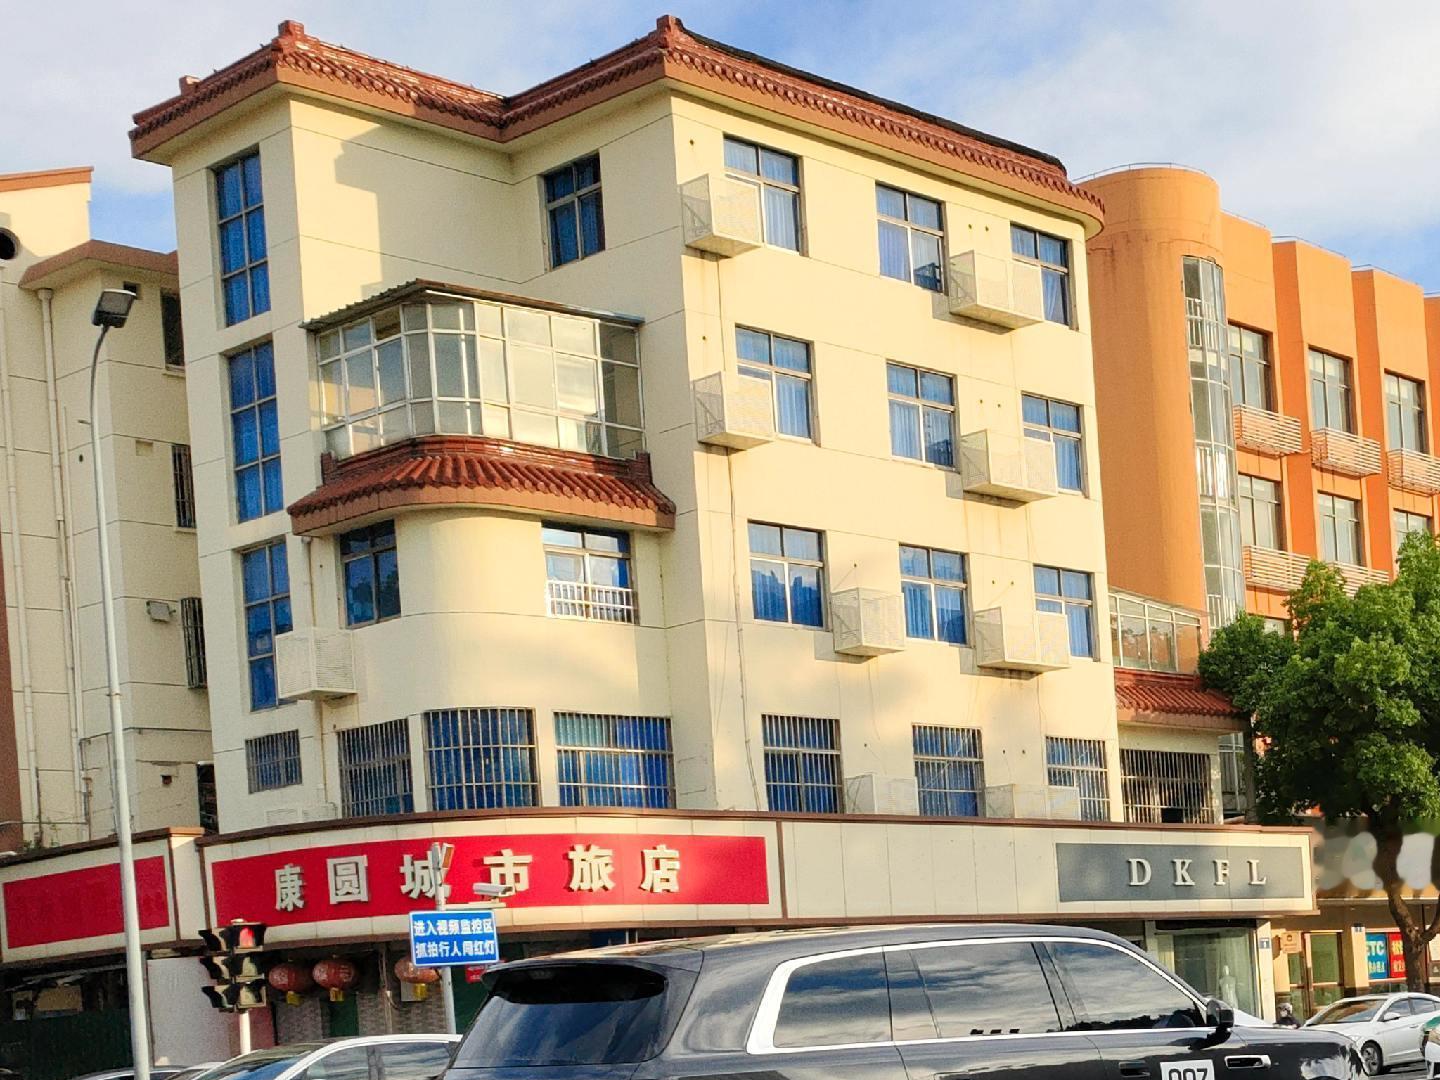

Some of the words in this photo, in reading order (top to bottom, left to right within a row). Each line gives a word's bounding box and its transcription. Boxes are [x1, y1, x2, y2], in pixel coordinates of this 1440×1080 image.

[274, 844, 681, 912] 康圆城市旅店
[1128, 858, 1267, 886] DKFL
[413, 918, 494, 936] 进入视频监控区
